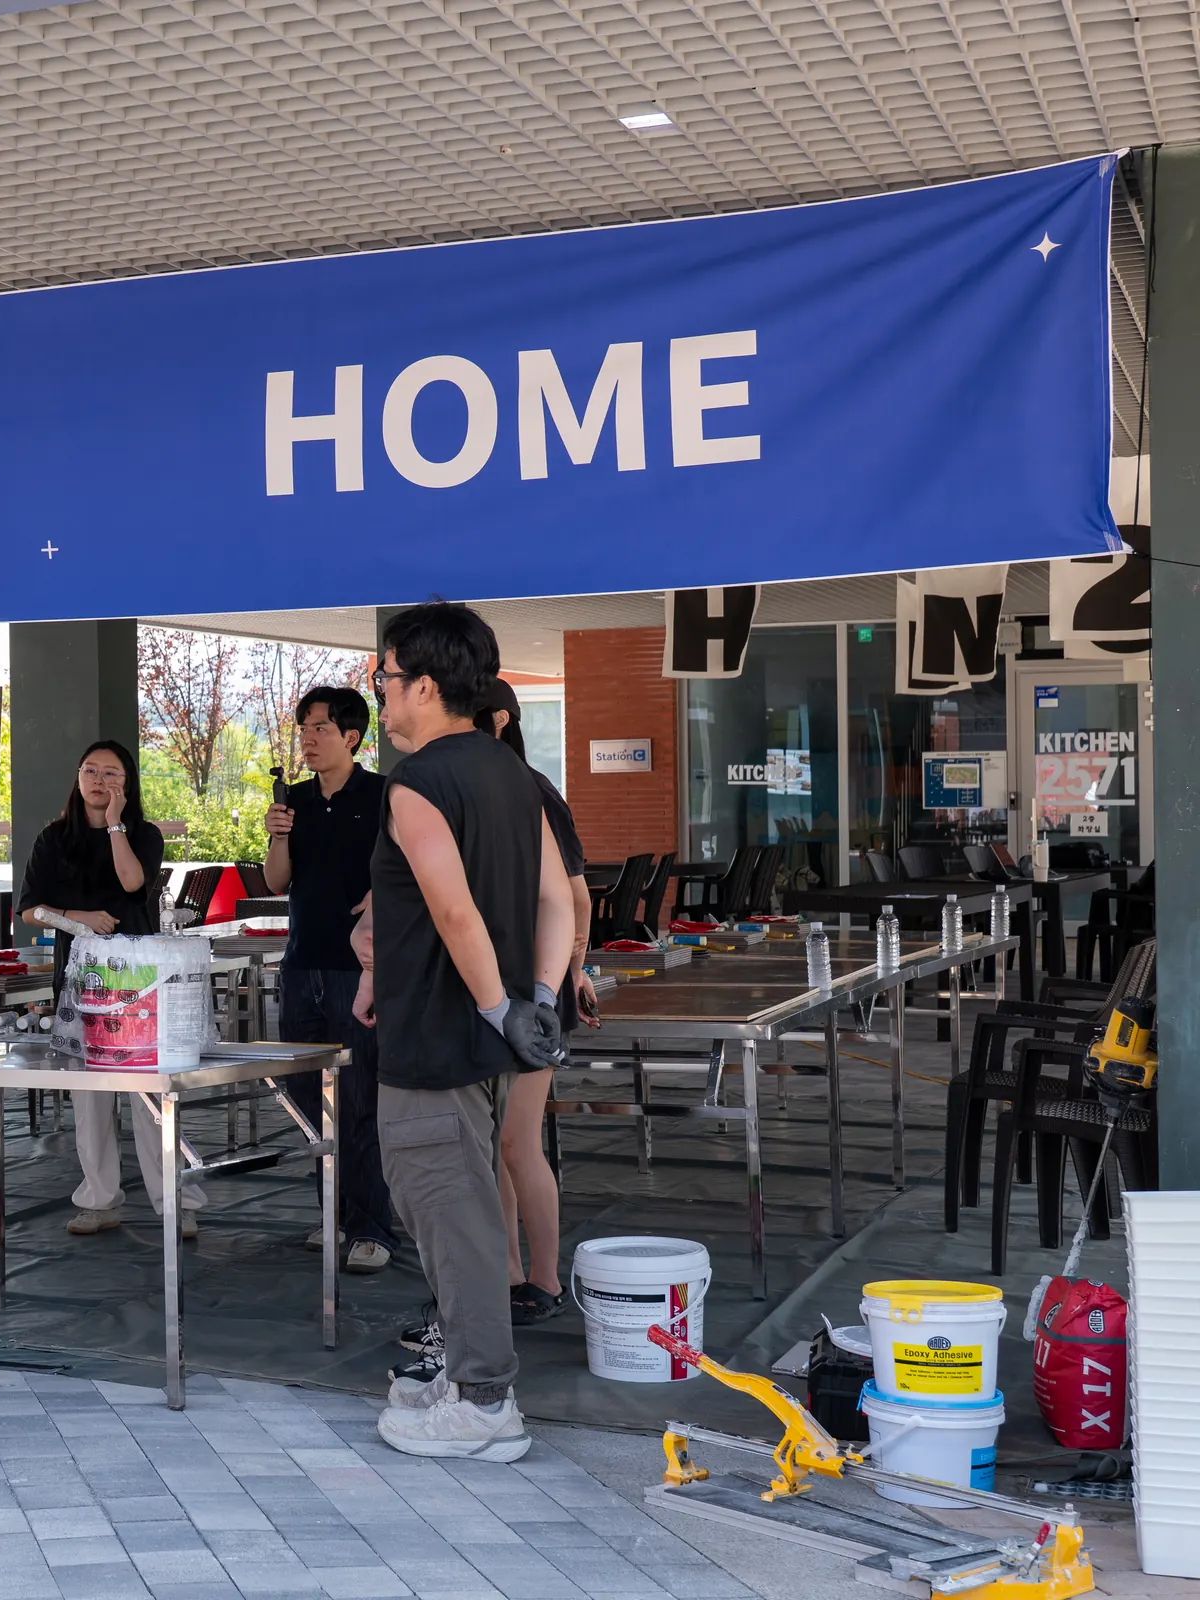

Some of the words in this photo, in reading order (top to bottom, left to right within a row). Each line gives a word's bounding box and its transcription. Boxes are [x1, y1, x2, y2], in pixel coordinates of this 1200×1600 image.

[265, 330, 761, 496] HOME
[1039, 731, 1135, 753] KITCHEN
[1041, 757, 1135, 796] 2571
[1078, 826, 1101, 834] 화장실
[929, 1338, 949, 1349] ARDEX
[904, 1348, 930, 1358] Epoxy
[933, 1351, 973, 1359] Adhesive
